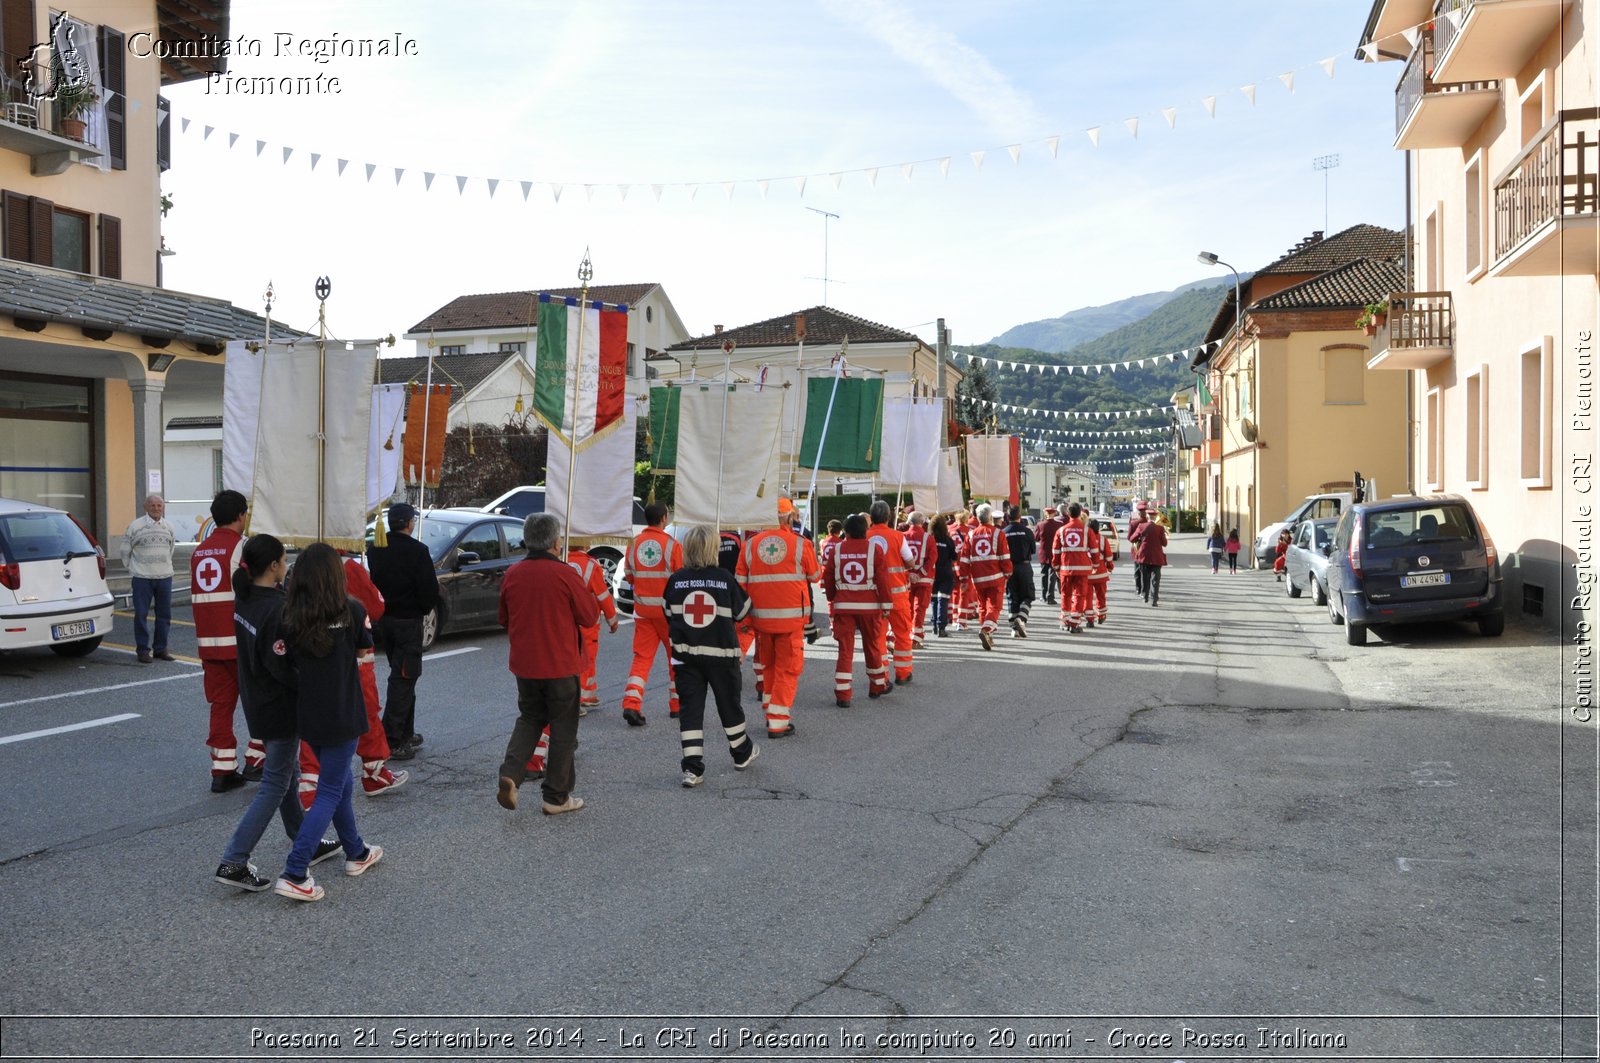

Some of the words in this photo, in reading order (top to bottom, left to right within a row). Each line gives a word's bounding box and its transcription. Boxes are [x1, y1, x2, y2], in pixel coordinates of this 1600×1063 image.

[674, 580, 690, 589] CROCE
[690, 580, 705, 588] ROSSA
[705, 580, 728, 590] ITALIANA
[1406, 577, 1417, 586] DN
[1419, 574, 1445, 585] 449WC
[58, 626, 67, 637] DL
[69, 622, 90, 635] 678XB
